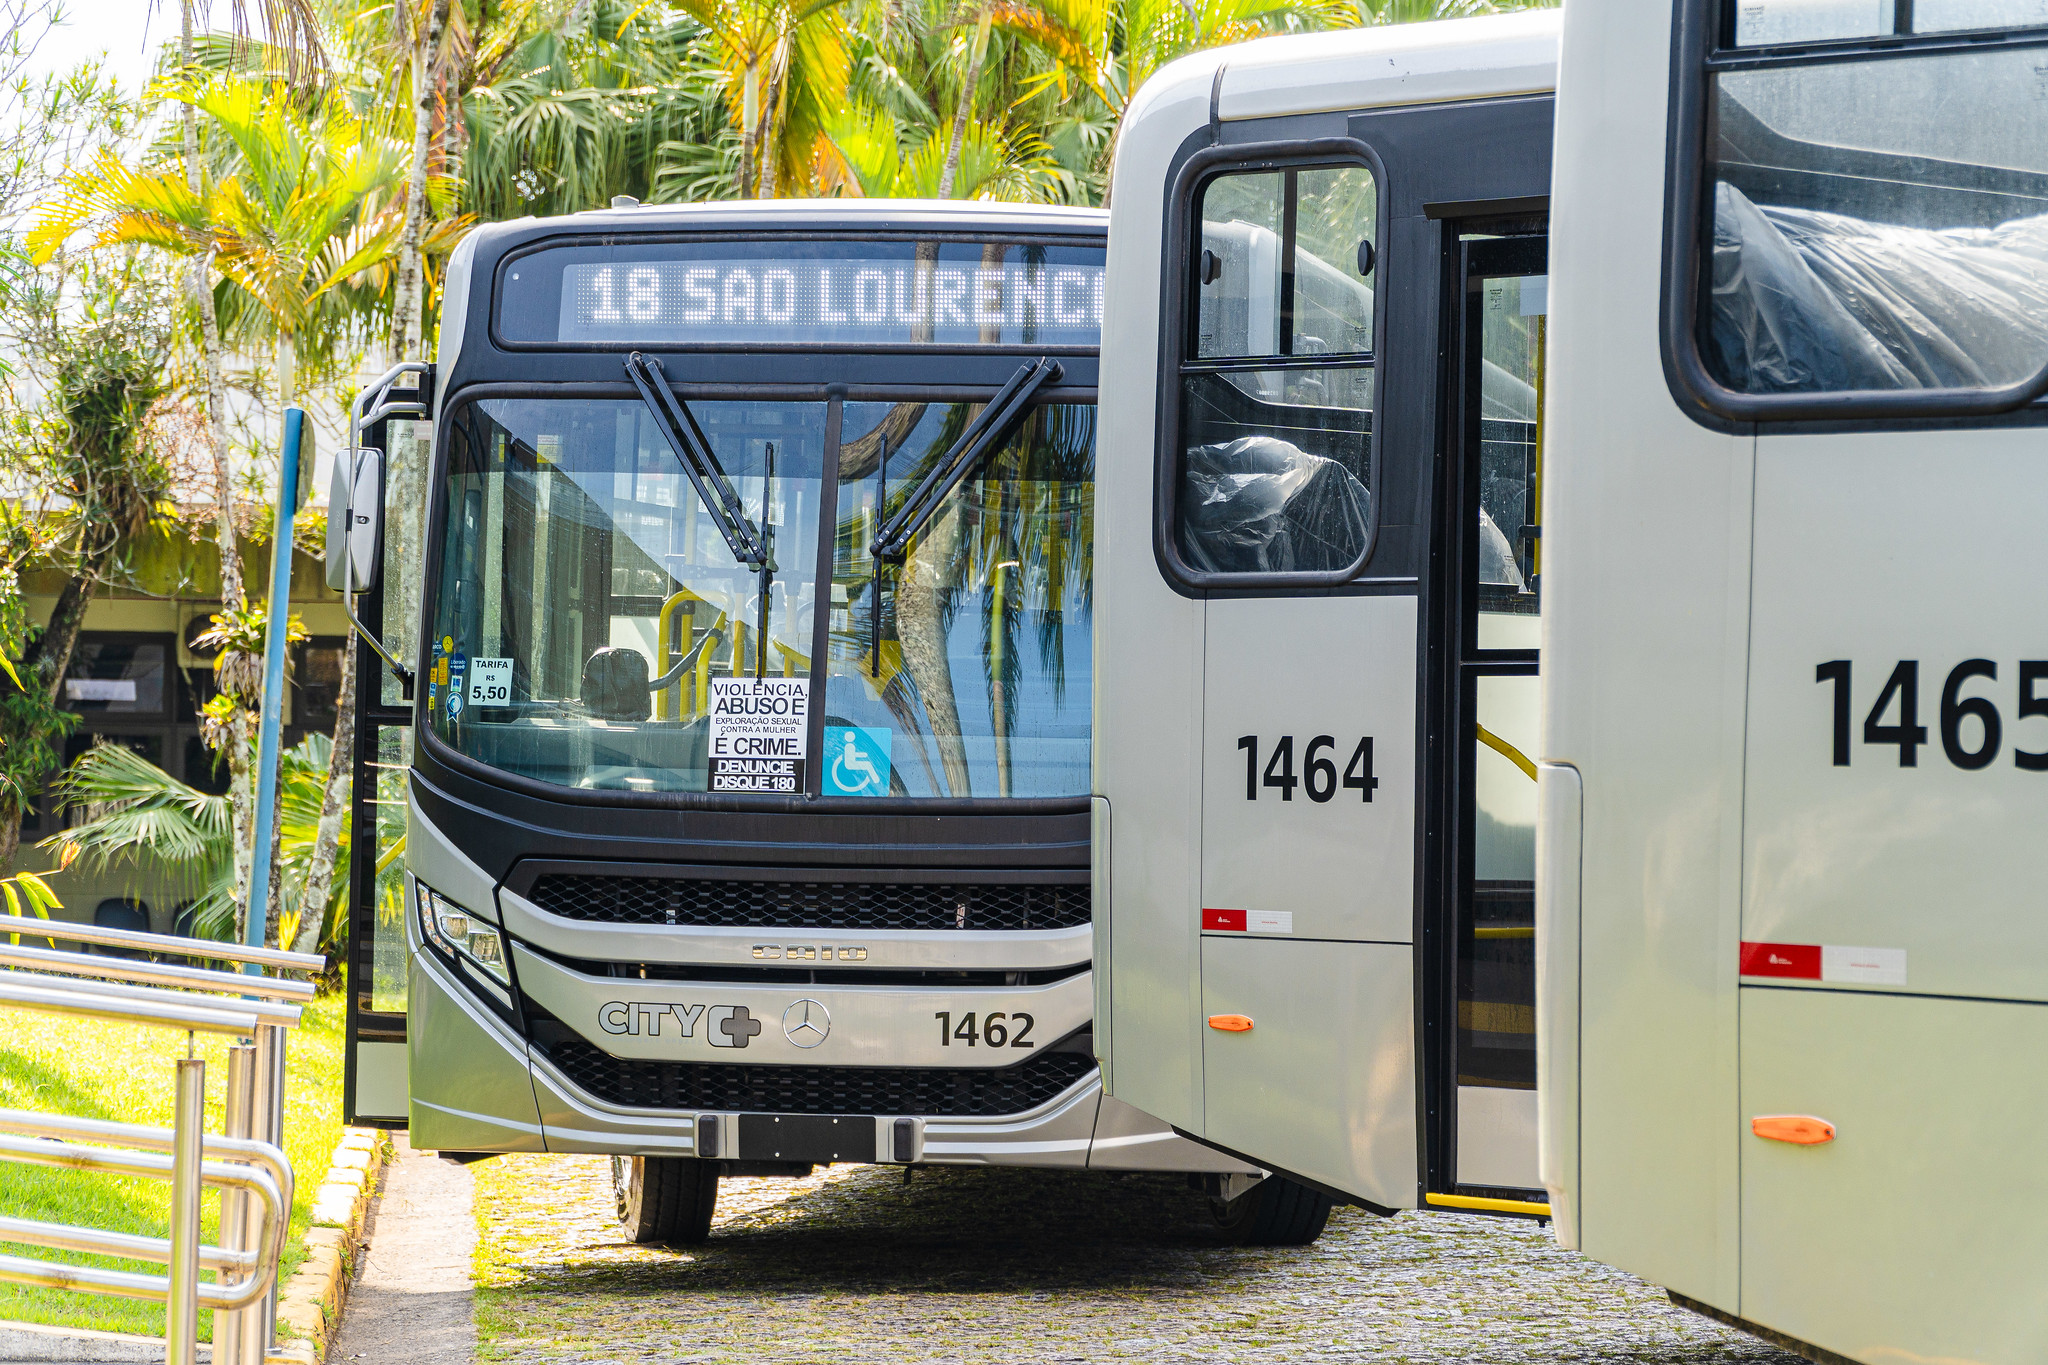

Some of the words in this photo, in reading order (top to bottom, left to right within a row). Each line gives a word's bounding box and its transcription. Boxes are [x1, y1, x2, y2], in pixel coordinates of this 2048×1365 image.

[594, 268, 661, 322] 18
[684, 268, 796, 323] SAO
[475, 660, 508, 669] TARIFA
[472, 686, 507, 702] 5,50
[714, 697, 789, 715] ABUSO
[792, 698, 805, 716] E
[1815, 658, 2048, 772] 1465
[715, 716, 770, 726] EXPLORAÇÃO
[771, 717, 802, 726] SEXUAL
[762, 726, 797, 734] MULHER
[715, 733, 728, 755] É
[734, 737, 802, 756] CRIME.
[717, 760, 794, 774] DENUNCIE
[1237, 735, 1379, 803] 1464
[713, 775, 771, 790] DISQUE
[772, 777, 796, 790] 180
[752, 944, 868, 961] CAIO
[598, 1001, 706, 1037] CITY
[935, 1011, 1035, 1048] 1462
